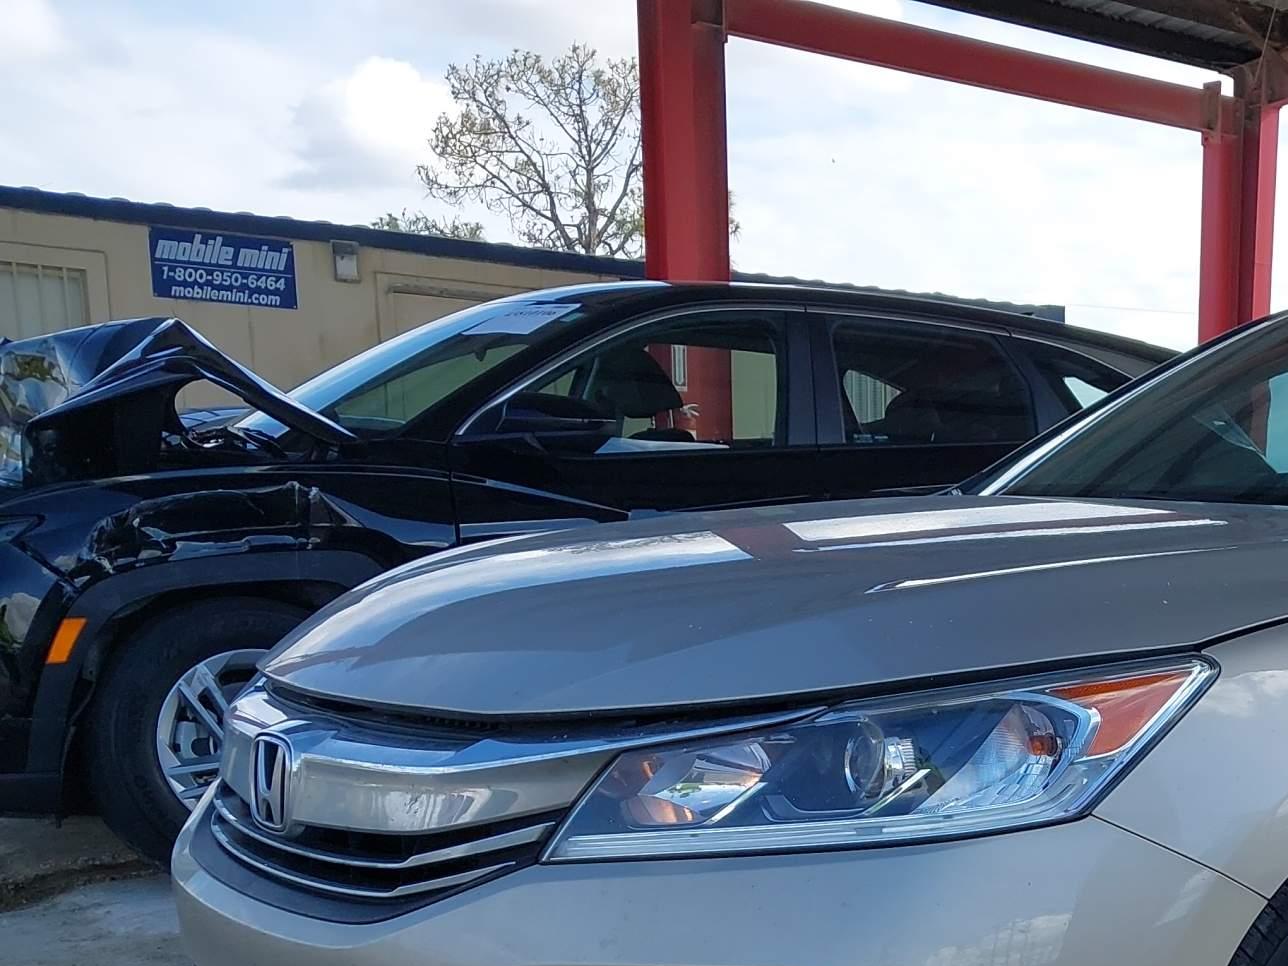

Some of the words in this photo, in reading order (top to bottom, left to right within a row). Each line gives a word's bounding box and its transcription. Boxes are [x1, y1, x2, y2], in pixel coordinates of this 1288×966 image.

[154, 233, 234, 265] mobile
[237, 245, 289, 271] mini
[162, 266, 286, 291] 1-800-950-6464
[171, 285, 281, 306] mobilemini.com
